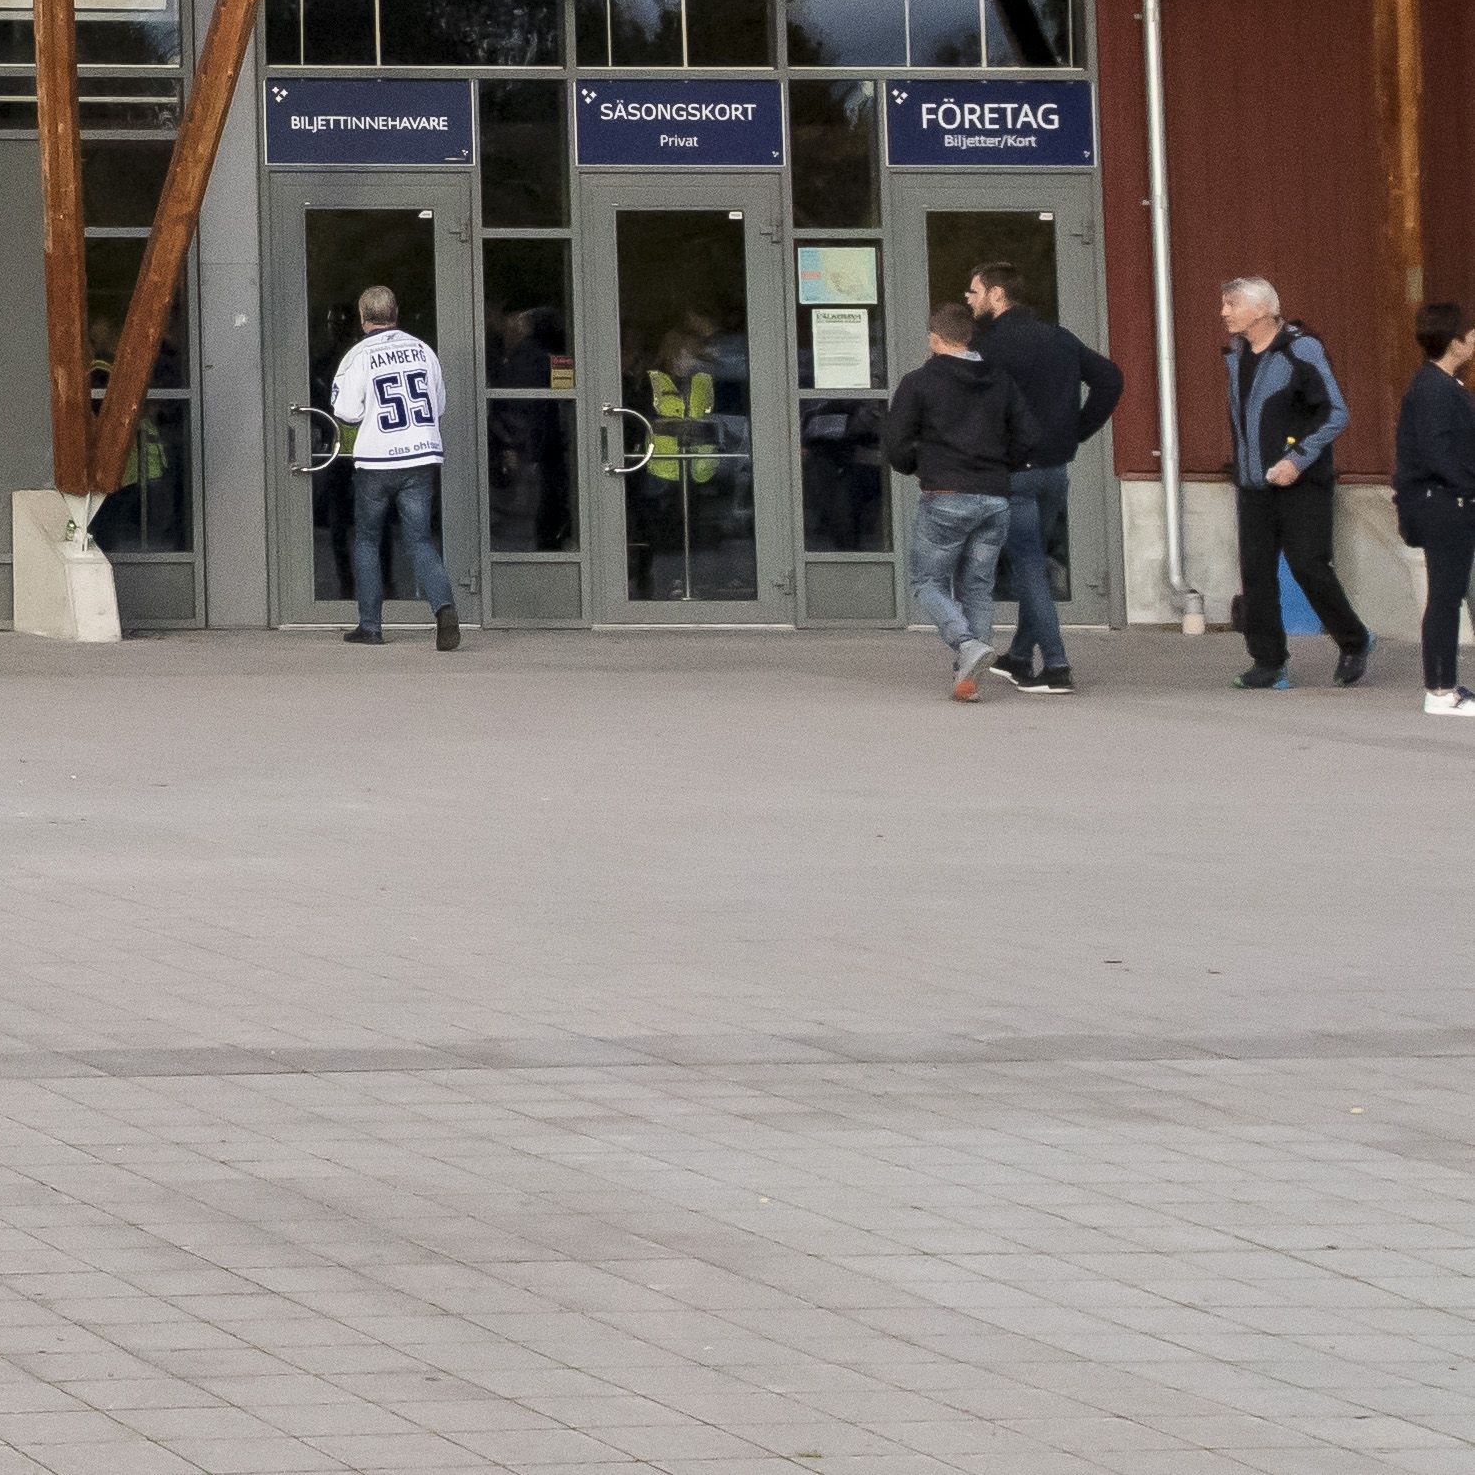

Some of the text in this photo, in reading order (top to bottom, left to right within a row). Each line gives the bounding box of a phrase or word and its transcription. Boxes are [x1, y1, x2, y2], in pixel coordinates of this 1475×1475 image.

[600, 99, 757, 121] SÄSONGSKORT
[921, 98, 1060, 130] FÖRETAG
[290, 115, 449, 132] BILJETTINNEHAVARE
[659, 134, 699, 147] Privat
[944, 134, 1037, 149] Biljetter/Kort
[373, 369, 436, 433] 55
